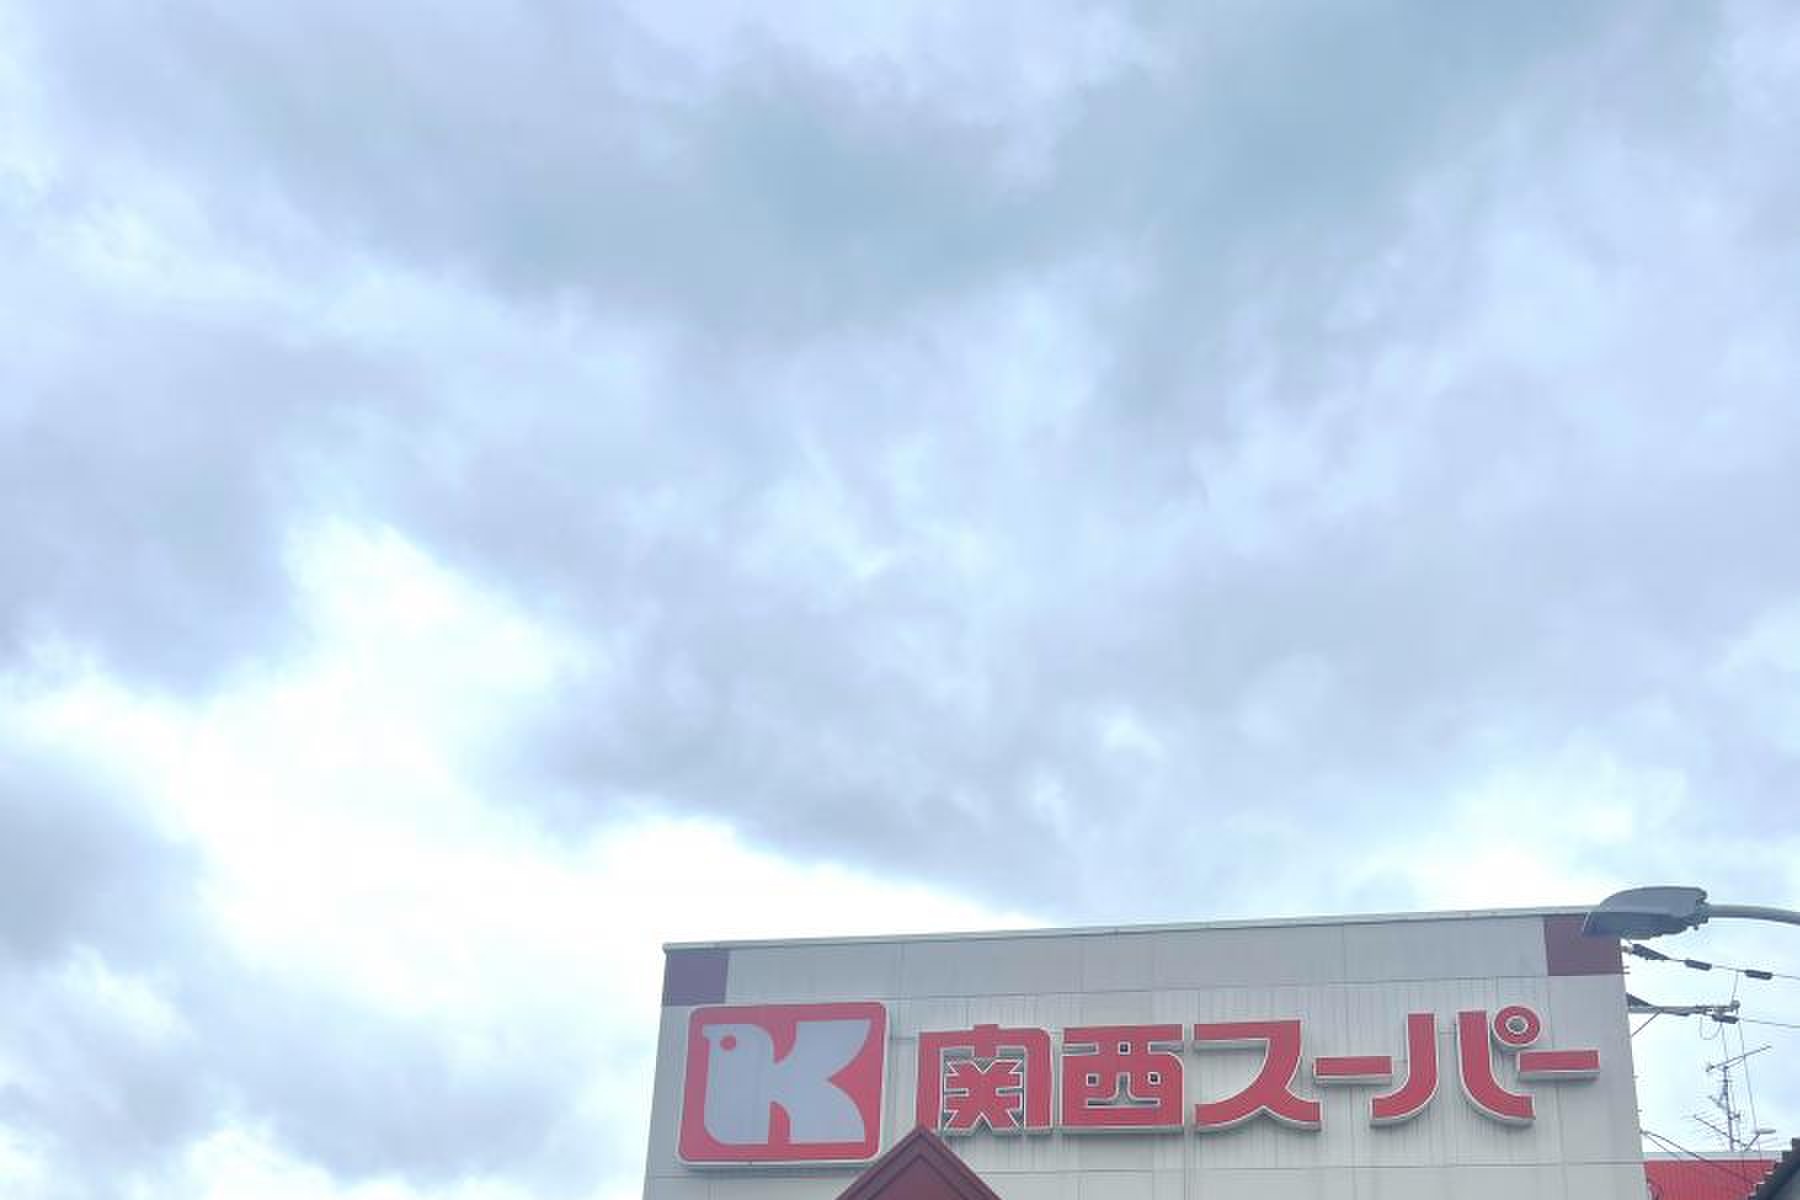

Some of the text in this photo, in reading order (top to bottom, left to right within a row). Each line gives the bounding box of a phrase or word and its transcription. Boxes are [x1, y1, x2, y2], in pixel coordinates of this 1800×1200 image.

[915, 1005, 1600, 1136] 関西スーパー
